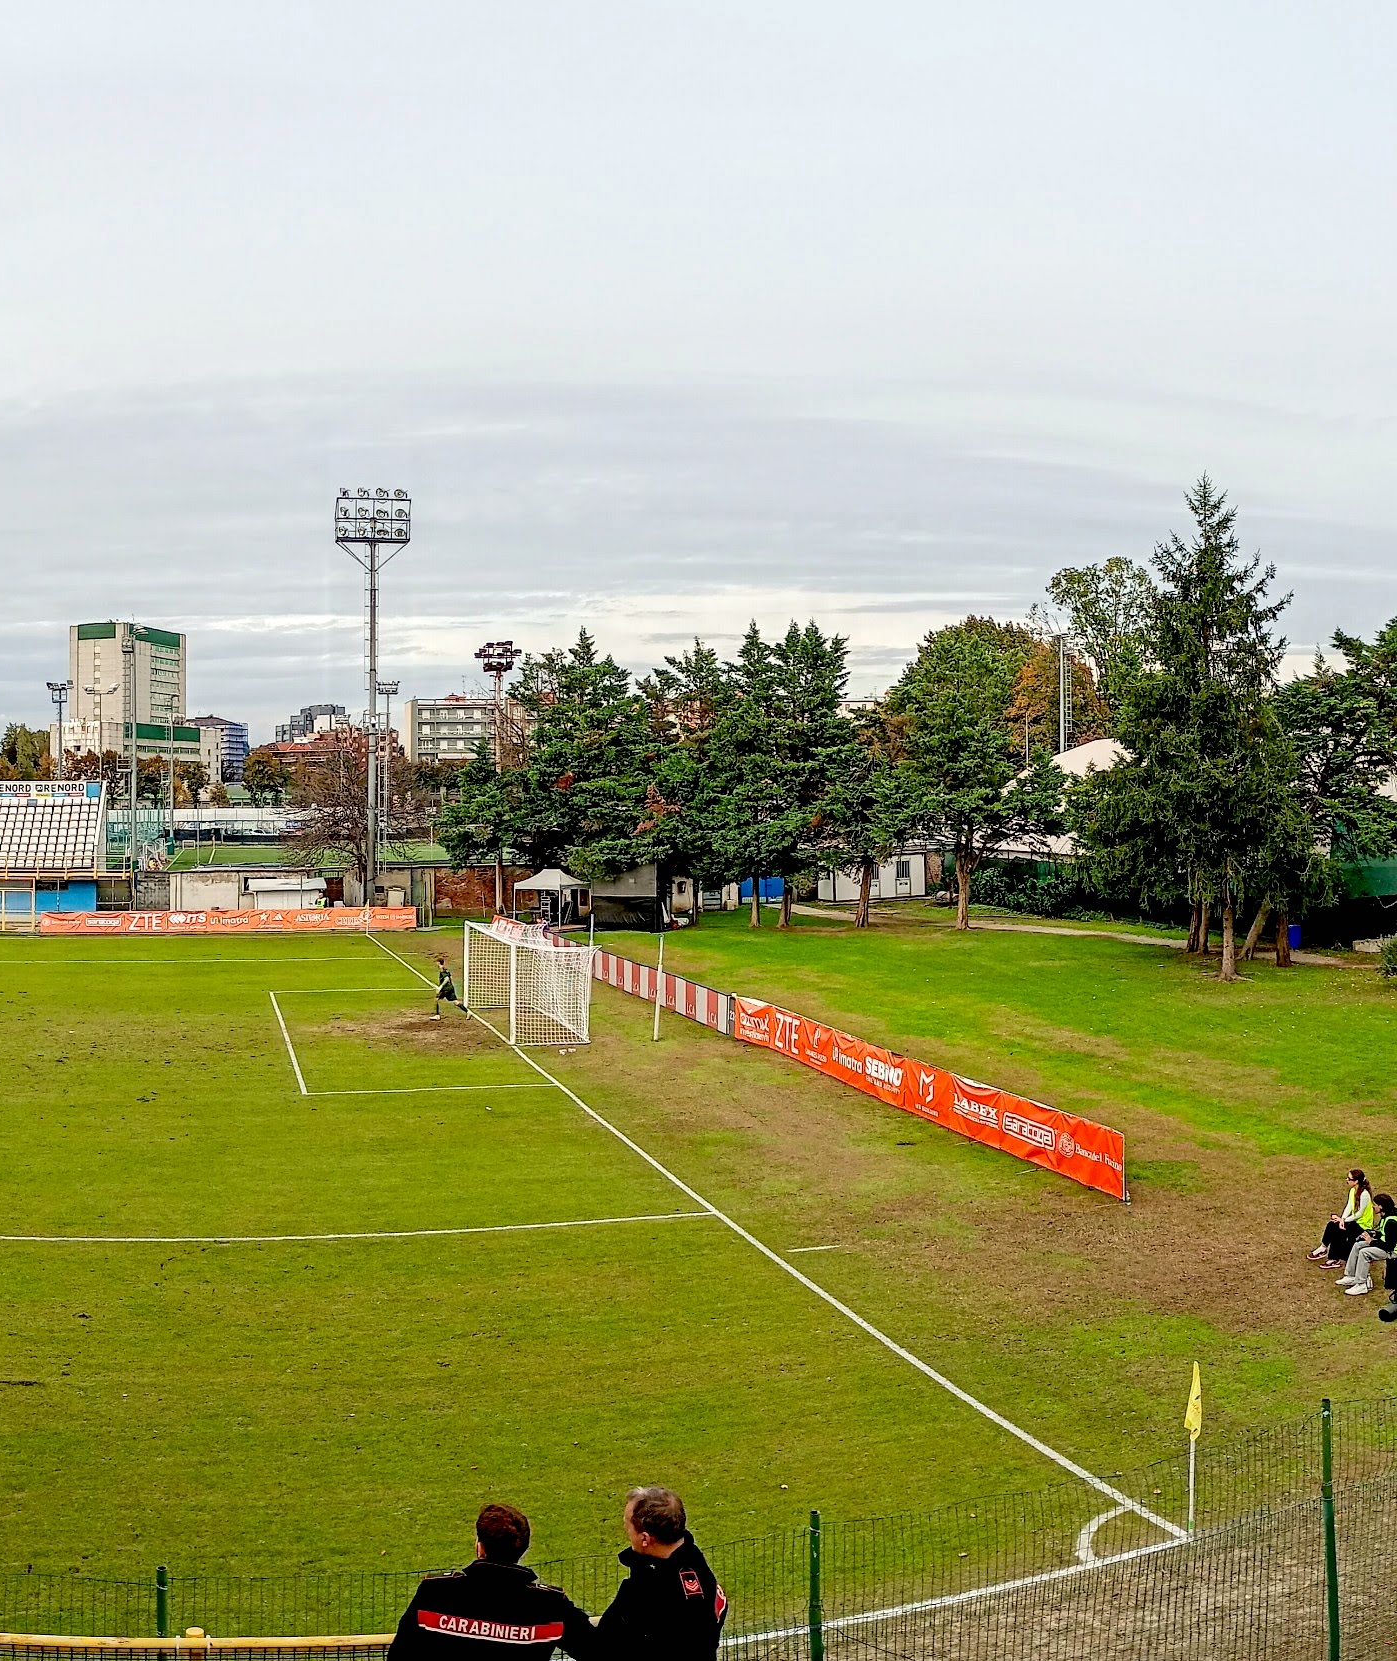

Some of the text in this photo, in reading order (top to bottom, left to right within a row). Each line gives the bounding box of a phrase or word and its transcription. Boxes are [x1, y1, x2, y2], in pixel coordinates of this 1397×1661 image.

[44, 784, 85, 793] RENORD
[128, 913, 163, 931] ZTE
[667, 994, 675, 1006] LCA
[686, 1002, 696, 1016] LCA
[708, 1011, 718, 1026] LCA
[774, 1012, 801, 1055] ZTE
[953, 1092, 999, 1121] LABEX
[1005, 1115, 1053, 1146] saratoga
[439, 1615, 536, 1641] CARABINIERI
